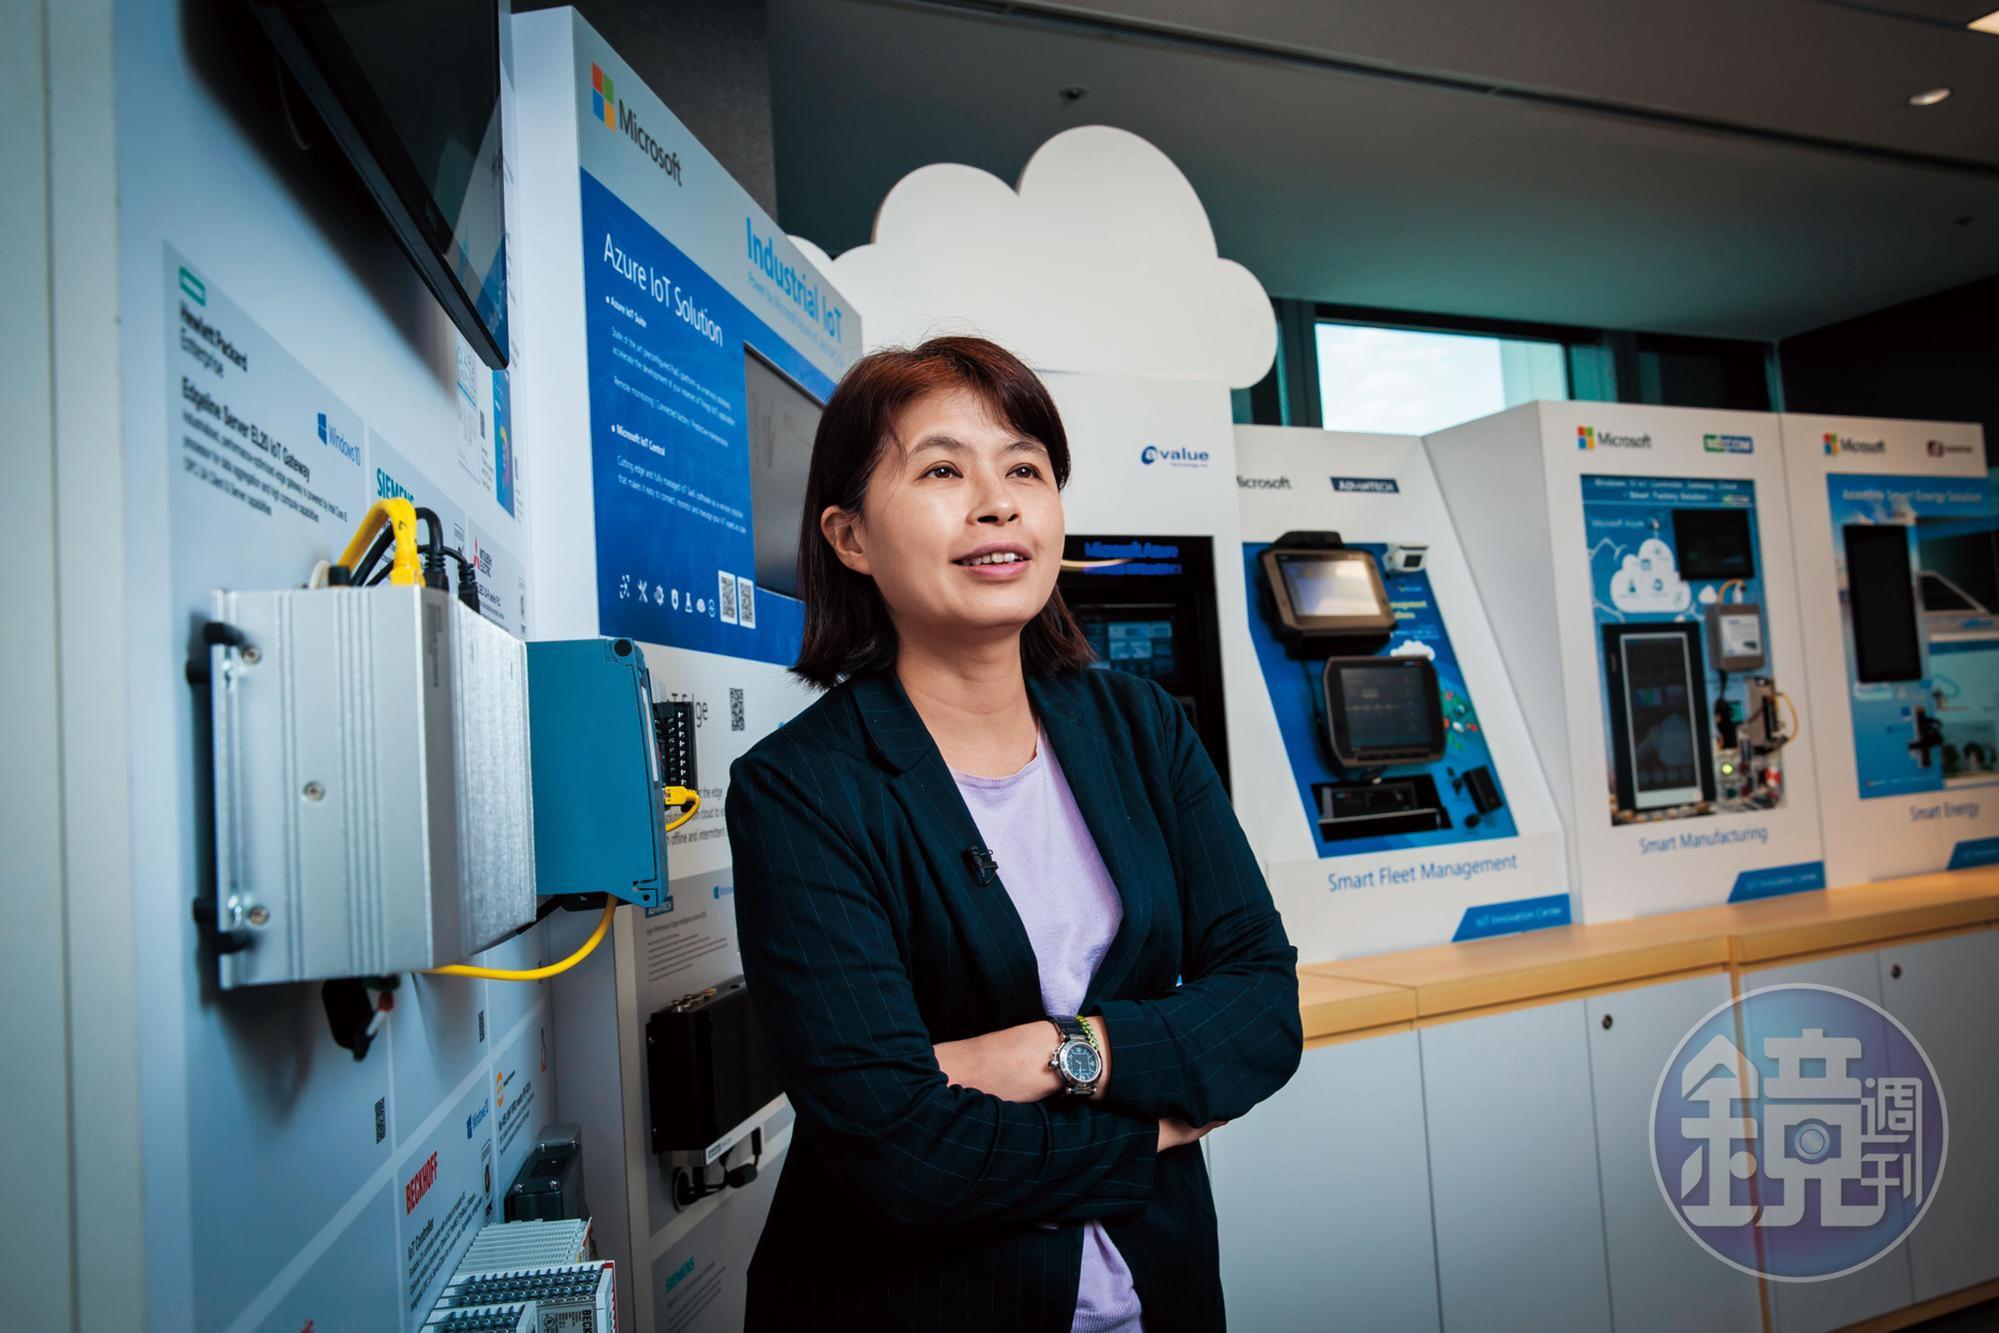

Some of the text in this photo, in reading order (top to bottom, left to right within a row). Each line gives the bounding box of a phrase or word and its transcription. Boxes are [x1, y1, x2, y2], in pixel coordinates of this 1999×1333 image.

[618, 99, 682, 186] Microsoft
[604, 233, 647, 290] Azure
[650, 267, 671, 308] IoT
[675, 287, 723, 347] Solution
[746, 216, 818, 324] Industrial
[822, 292, 842, 343] IoT
[223, 405, 249, 438] Server
[270, 437, 281, 460] IoT
[282, 447, 311, 483] Gateway
[1597, 432, 1652, 448] Microsoft
[1841, 438, 1886, 453] Microsoft
[1910, 801, 1980, 821] Smart Energy
[1640, 826, 1768, 854] Smart Manufacturing
[1328, 854, 1518, 891] Smart Fleet Management
[406, 1151, 438, 1216] BECKHOFF
